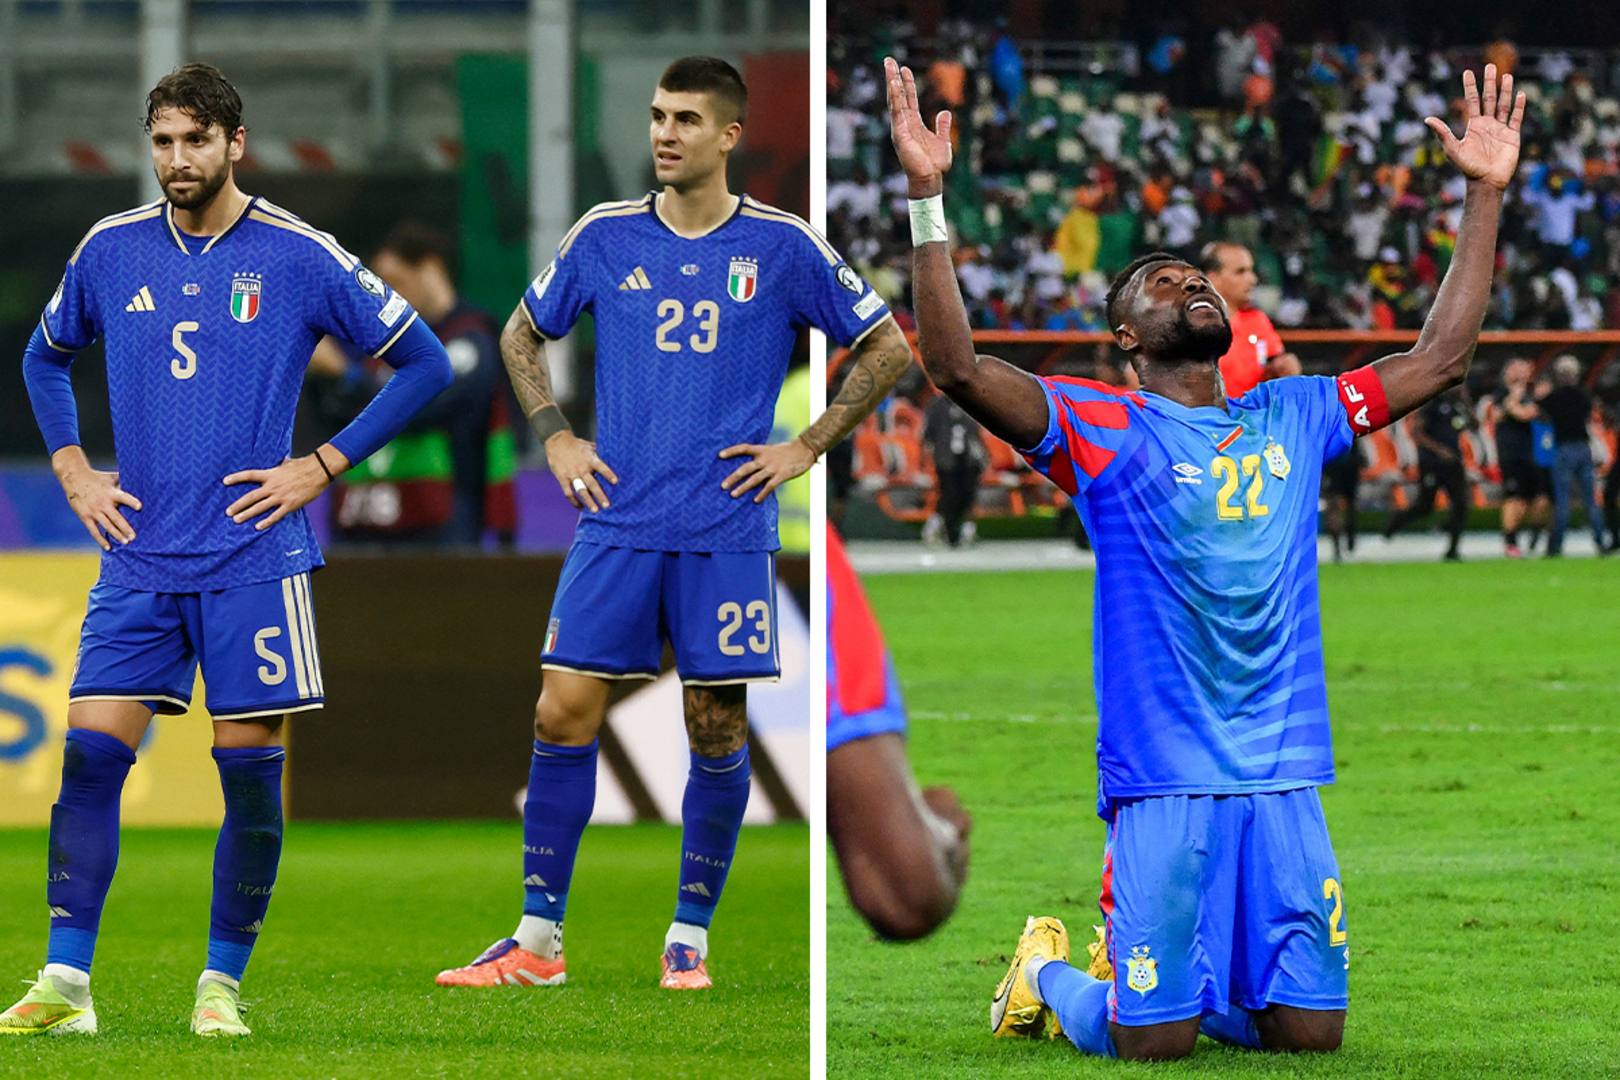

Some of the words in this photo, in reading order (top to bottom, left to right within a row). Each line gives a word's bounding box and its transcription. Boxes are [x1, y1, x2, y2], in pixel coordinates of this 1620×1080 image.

[234, 282, 259, 291] ITALIA
[171, 321, 199, 380] 5
[656, 299, 720, 353] 23
[1175, 476, 1202, 486] umbro
[1211, 455, 1269, 520] 22
[254, 626, 287, 686] 5
[717, 600, 770, 656] 23
[685, 851, 726, 868] ITALIA
[1323, 877, 1347, 947] 2
